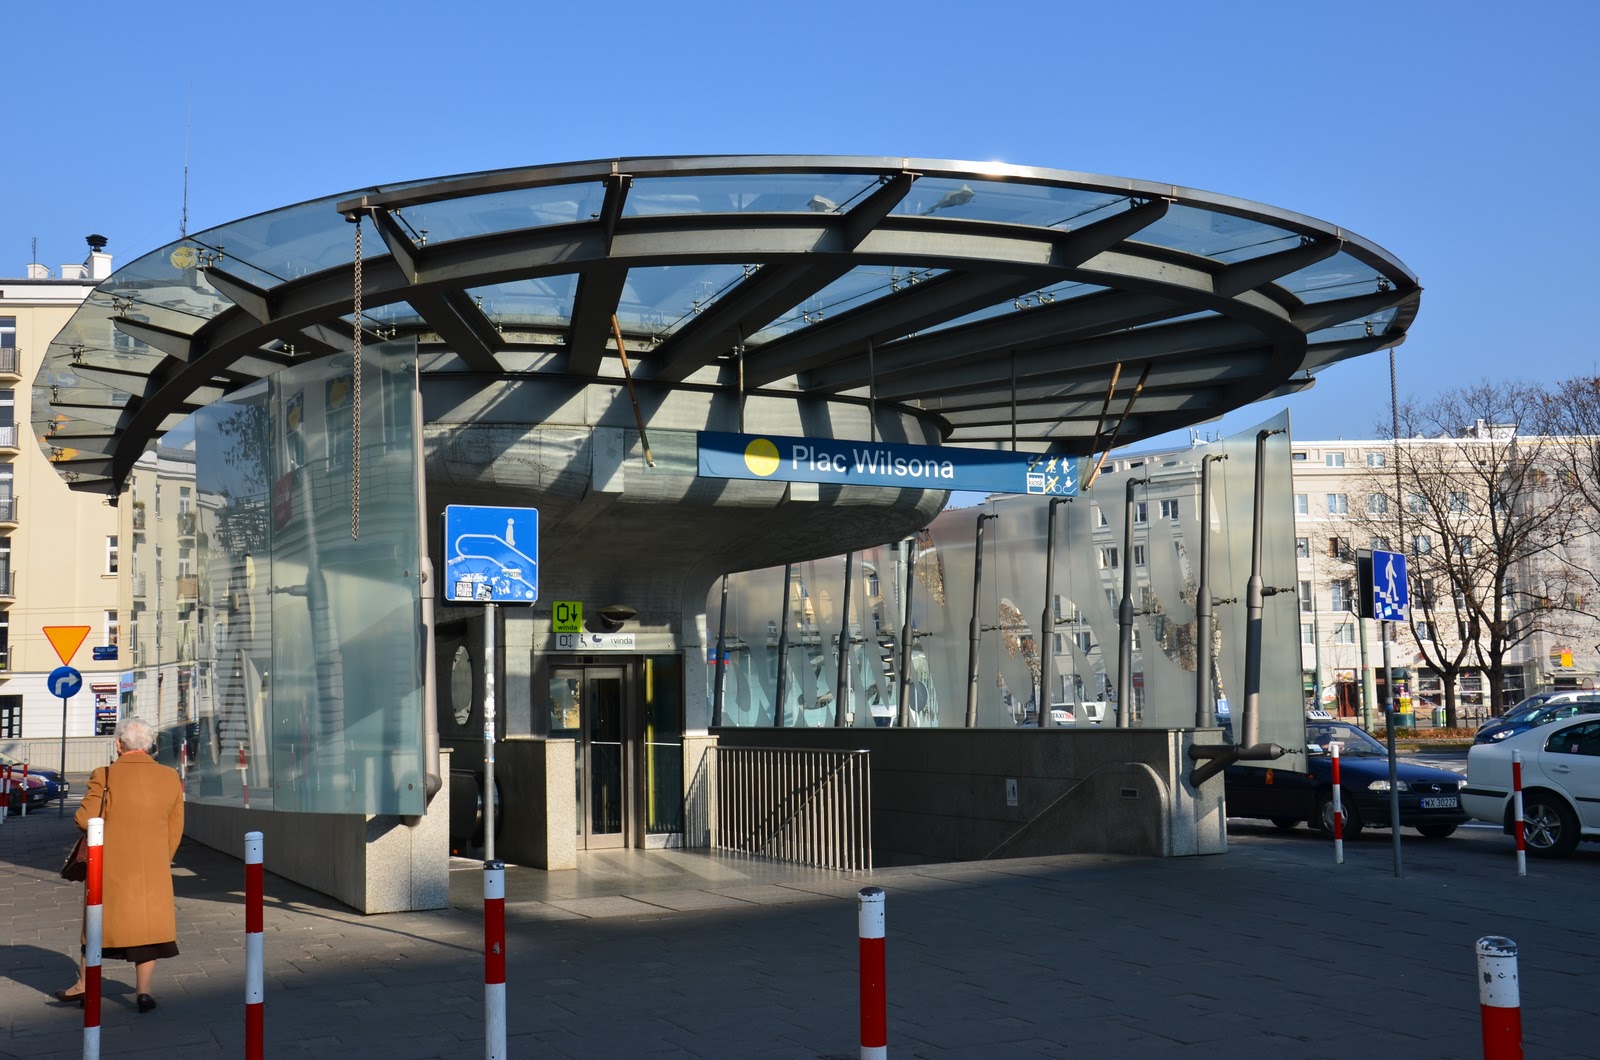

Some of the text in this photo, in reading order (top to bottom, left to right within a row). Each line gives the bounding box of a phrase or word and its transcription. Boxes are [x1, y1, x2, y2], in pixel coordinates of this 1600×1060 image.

[792, 445, 954, 479] Plac Wilsona
[1312, 710, 1331, 718] TAXI
[1425, 798, 1456, 807] WX 30227
